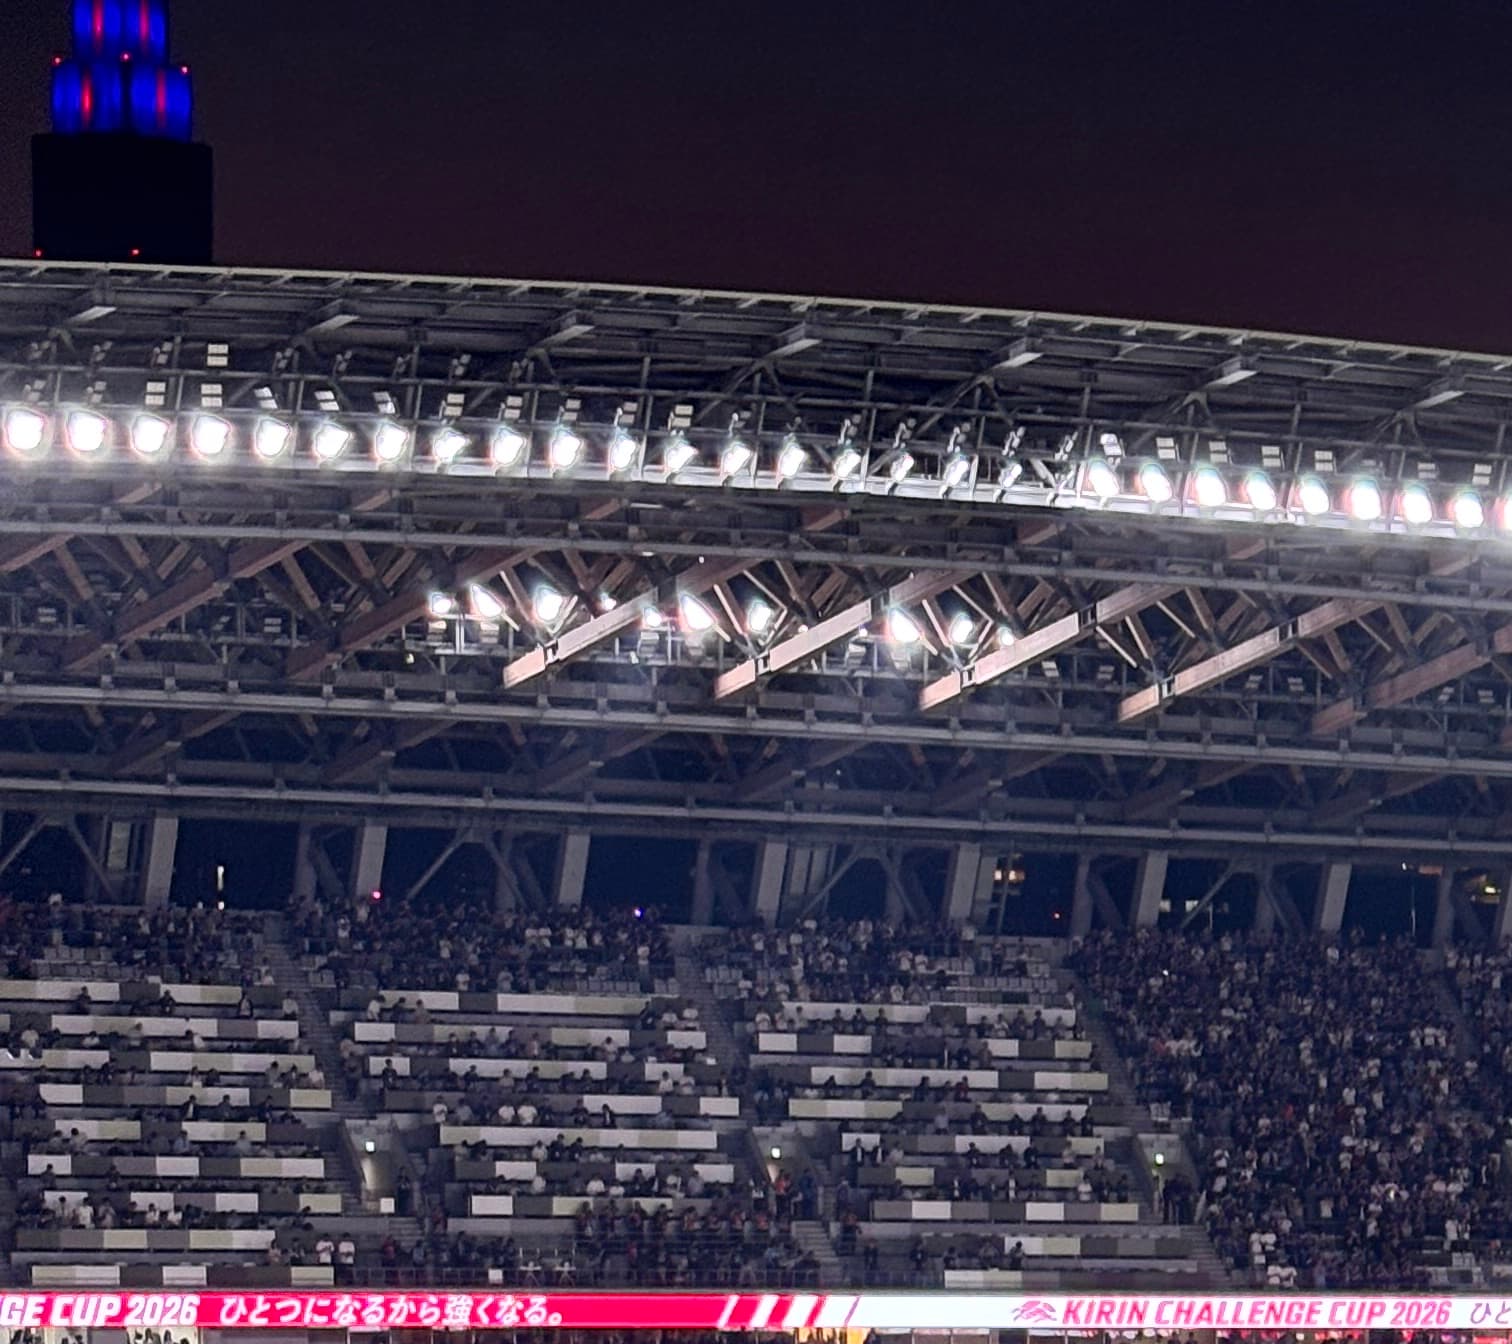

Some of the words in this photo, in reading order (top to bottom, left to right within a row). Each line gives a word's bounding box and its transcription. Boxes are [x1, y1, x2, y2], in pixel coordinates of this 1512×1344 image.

[50, 1295, 121, 1327] CUP
[124, 1294, 200, 1325] 2026
[219, 1294, 563, 1326] ひとつになるから強くなる。
[1061, 1300, 1150, 1325] KIRIN
[1154, 1300, 1321, 1325] CHALLENGE
[1328, 1300, 1386, 1325] CUP
[1390, 1300, 1452, 1325] 2026
